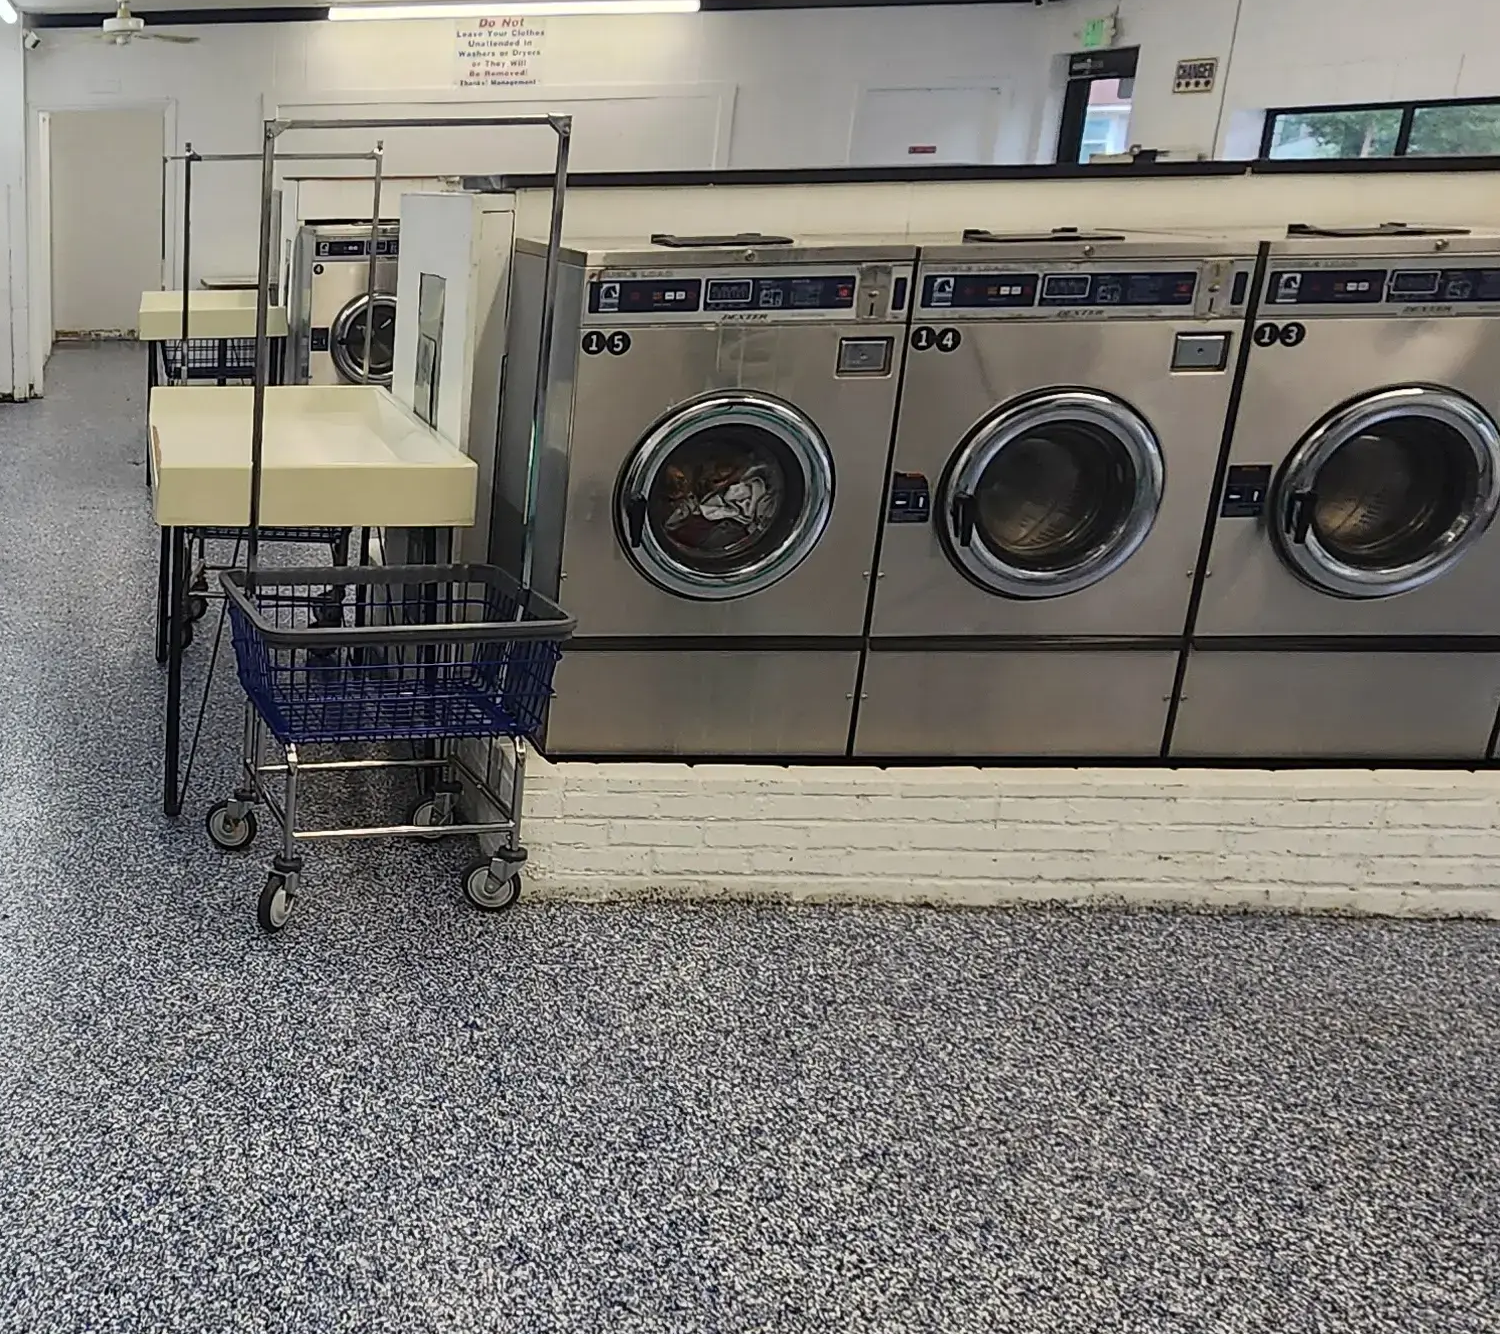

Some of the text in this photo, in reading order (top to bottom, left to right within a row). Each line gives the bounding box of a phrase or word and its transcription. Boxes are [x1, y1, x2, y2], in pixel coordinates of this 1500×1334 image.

[479, 17, 524, 28] Do Not
[456, 30, 483, 38] Leave
[511, 29, 545, 37] Clothes
[468, 40, 520, 48] Unattended
[512, 49, 541, 58] Dryers
[485, 60, 506, 68] They
[315, 265, 322, 274] 4
[916, 329, 955, 349] 14
[1259, 325, 1300, 344] 13
[587, 334, 625, 353] 15
